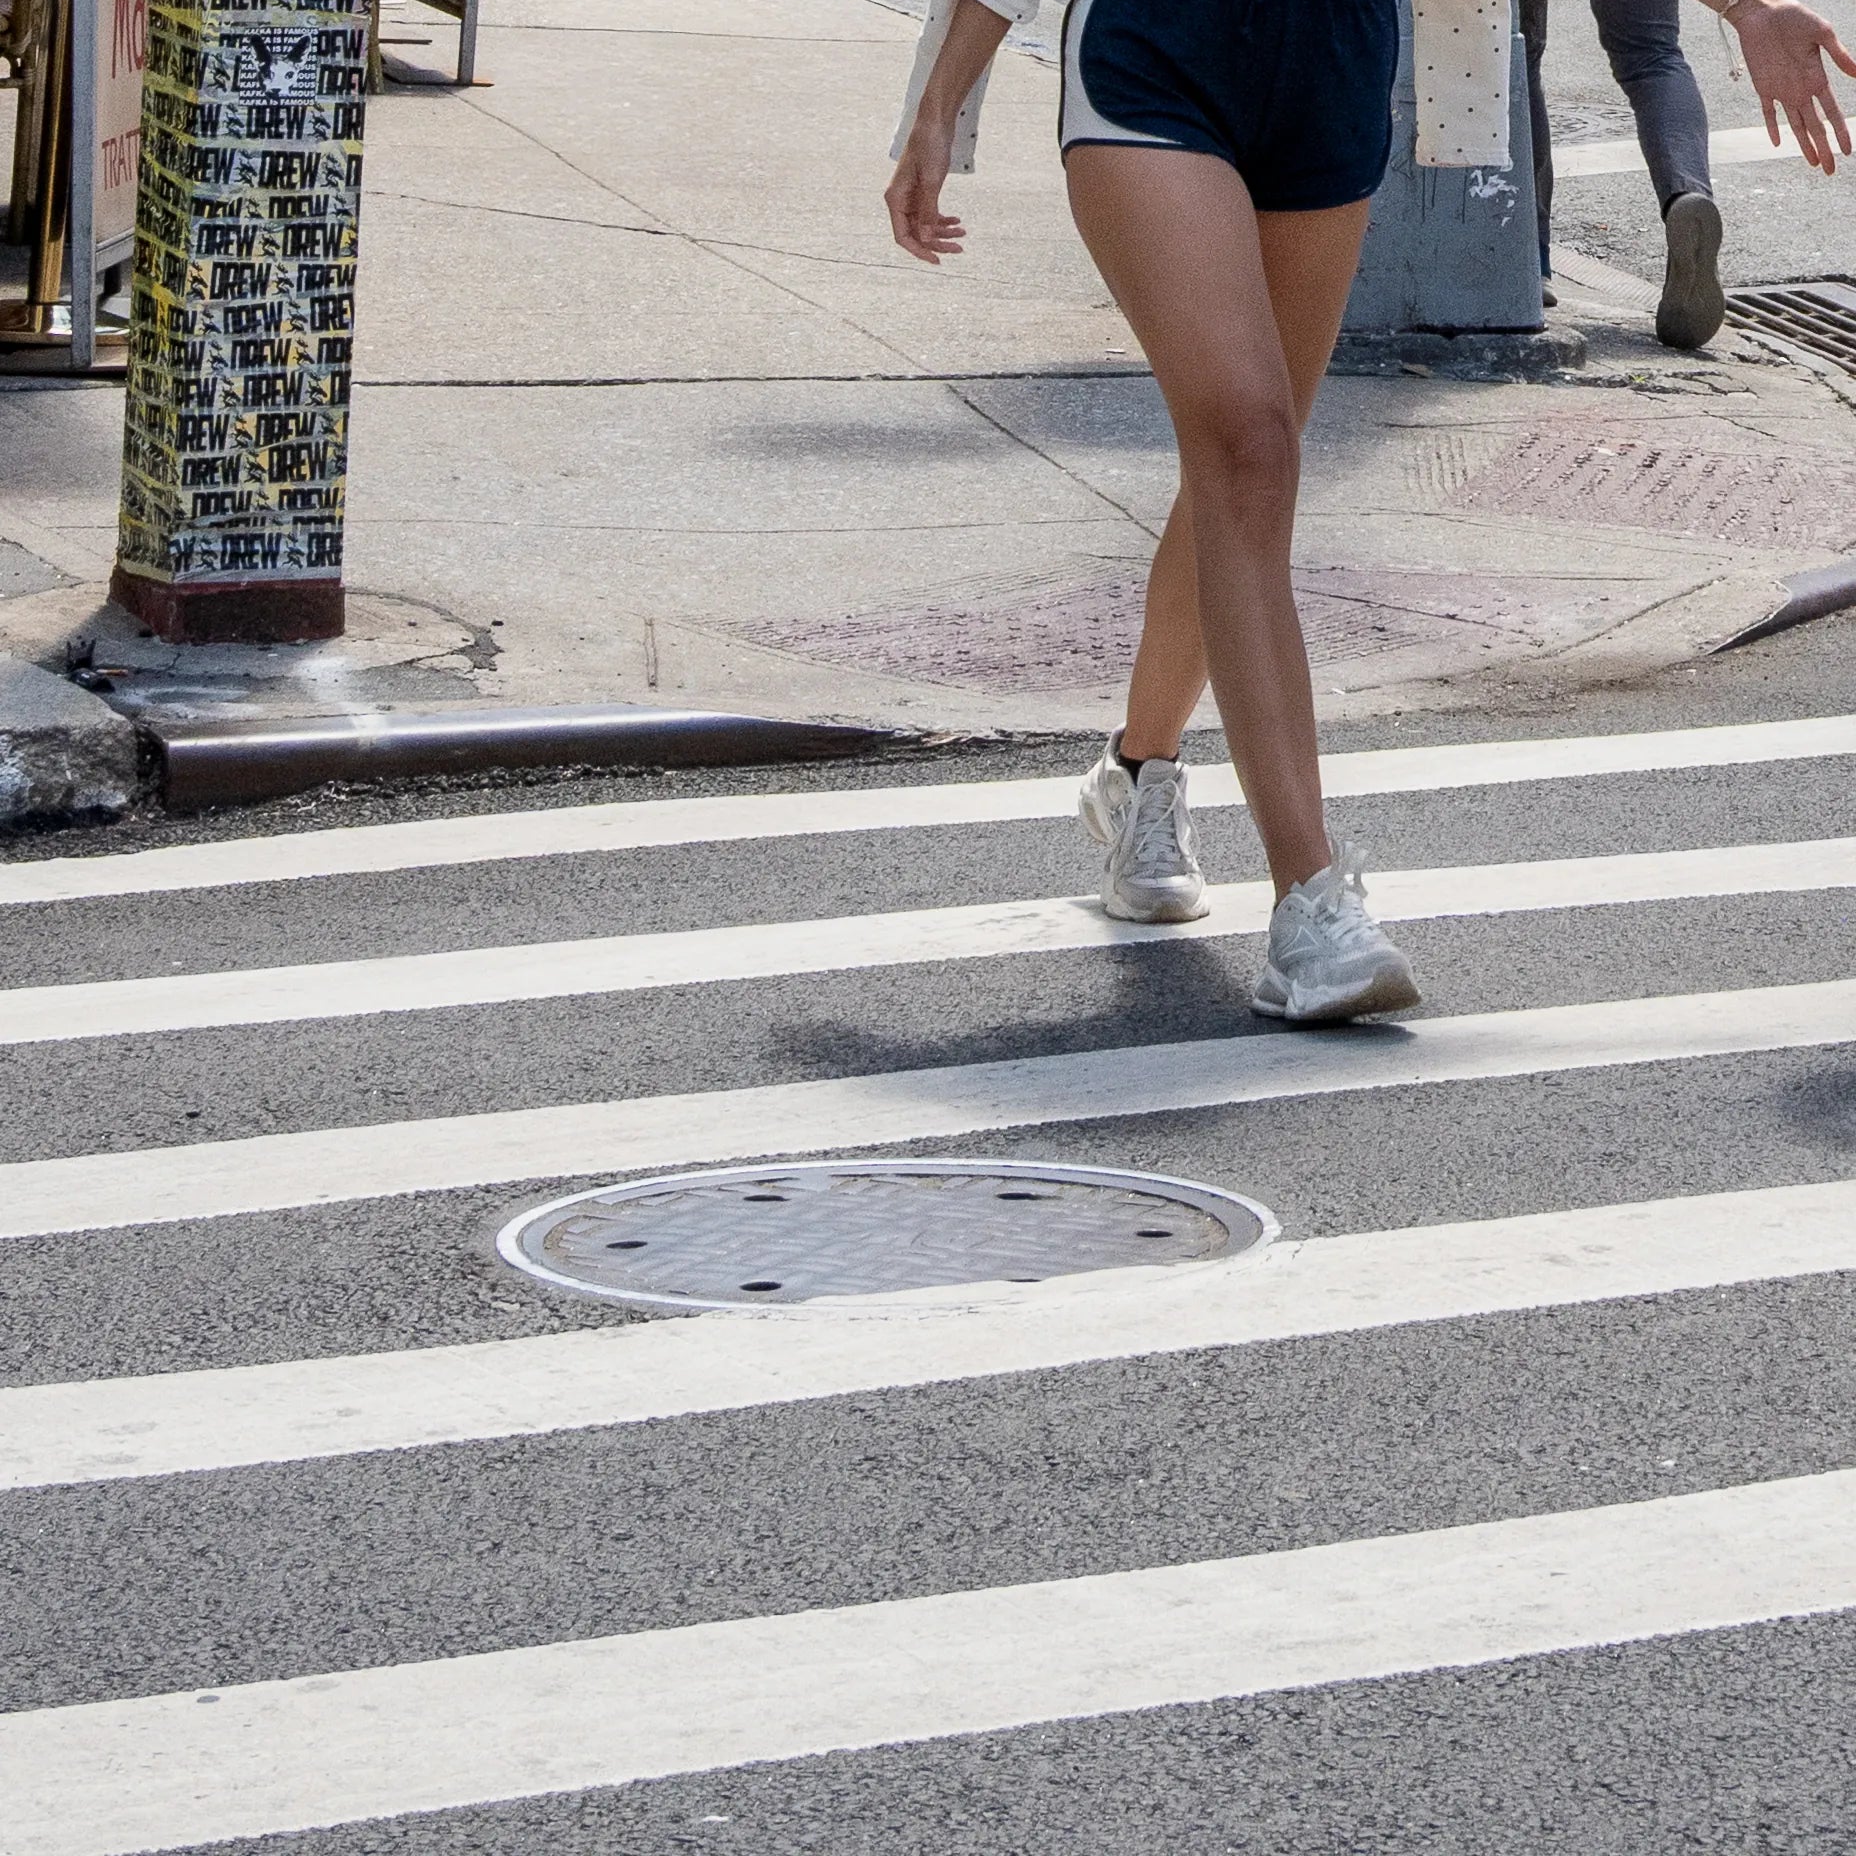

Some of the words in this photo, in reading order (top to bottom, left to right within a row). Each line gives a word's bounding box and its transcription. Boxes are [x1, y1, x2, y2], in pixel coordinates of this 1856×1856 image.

[246, 104, 308, 140] DREW
[259, 150, 322, 188] DREW
[196, 224, 259, 256] DREW
[282, 222, 344, 257] DREW
[209, 262, 272, 300] DREW
[182, 455, 244, 487] DREW
[268, 441, 330, 483] DREW
[220, 532, 283, 570] DREW
